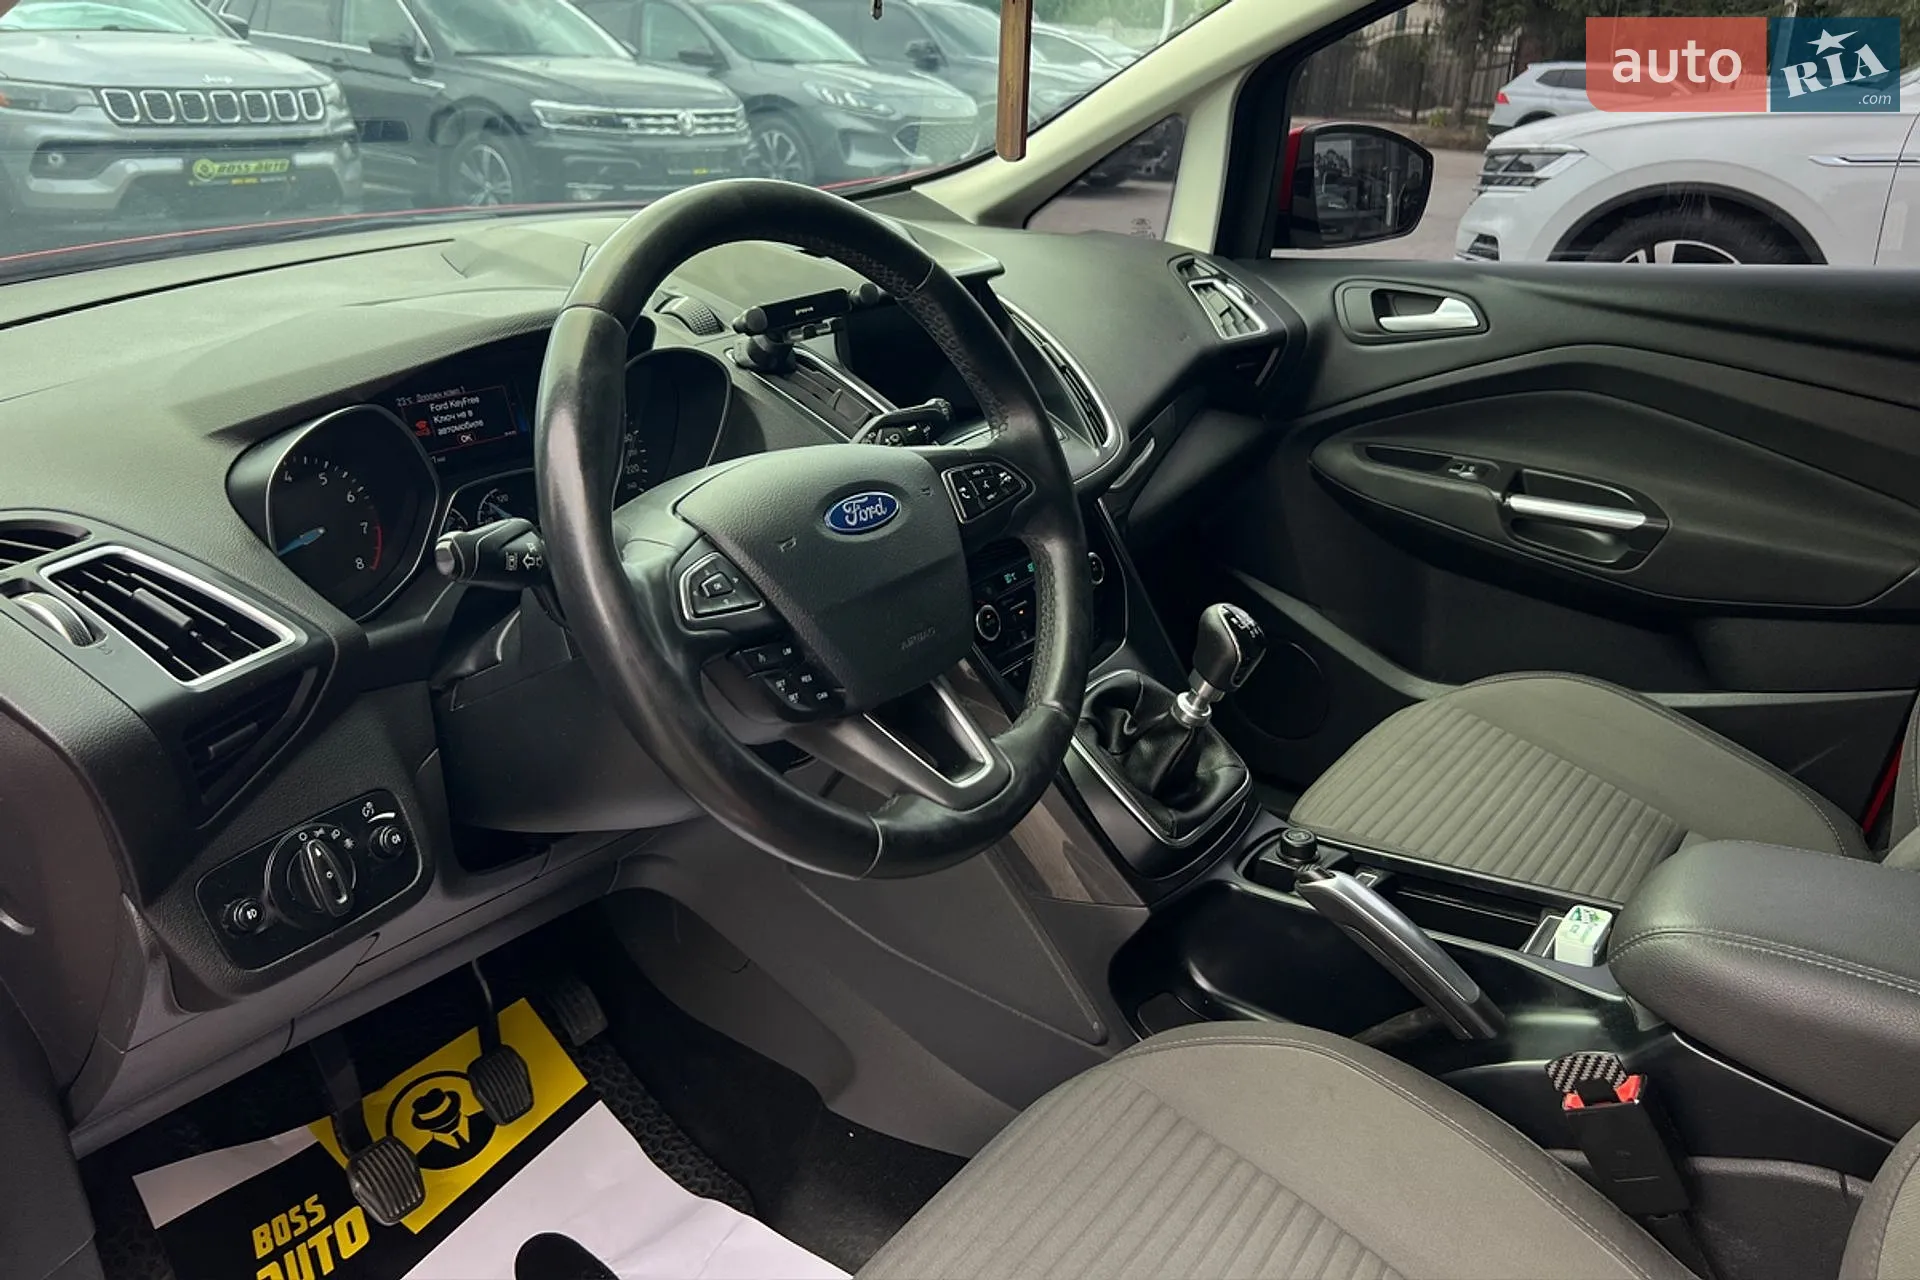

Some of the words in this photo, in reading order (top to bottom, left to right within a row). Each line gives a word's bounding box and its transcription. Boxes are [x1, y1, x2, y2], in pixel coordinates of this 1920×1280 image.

[430, 401, 449, 412] Ford
[460, 433, 473, 443] OK
[284, 471, 293, 483] 4
[318, 473, 328, 486] 5
[346, 491, 356, 503] 6
[842, 495, 887, 526] Ford
[360, 521, 368, 534] 7
[355, 557, 365, 570] 8
[252, 1193, 326, 1260] BOSS
